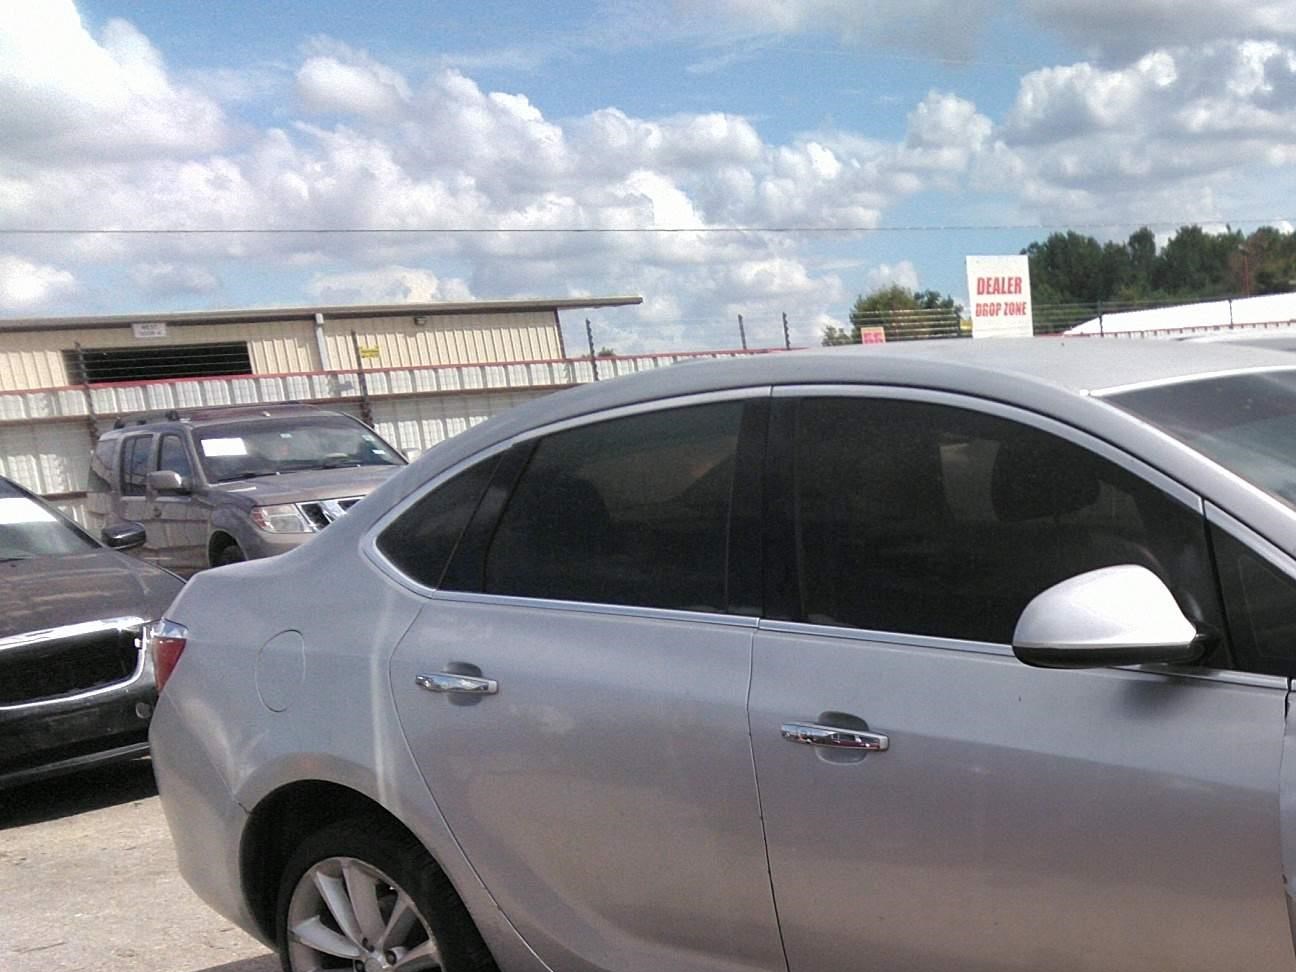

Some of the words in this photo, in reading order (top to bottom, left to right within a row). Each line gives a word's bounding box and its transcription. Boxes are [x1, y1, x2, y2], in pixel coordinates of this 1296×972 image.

[976, 276, 1022, 295] DEALER
[975, 302, 1002, 317] DROP
[1003, 301, 1027, 316] ZONE
